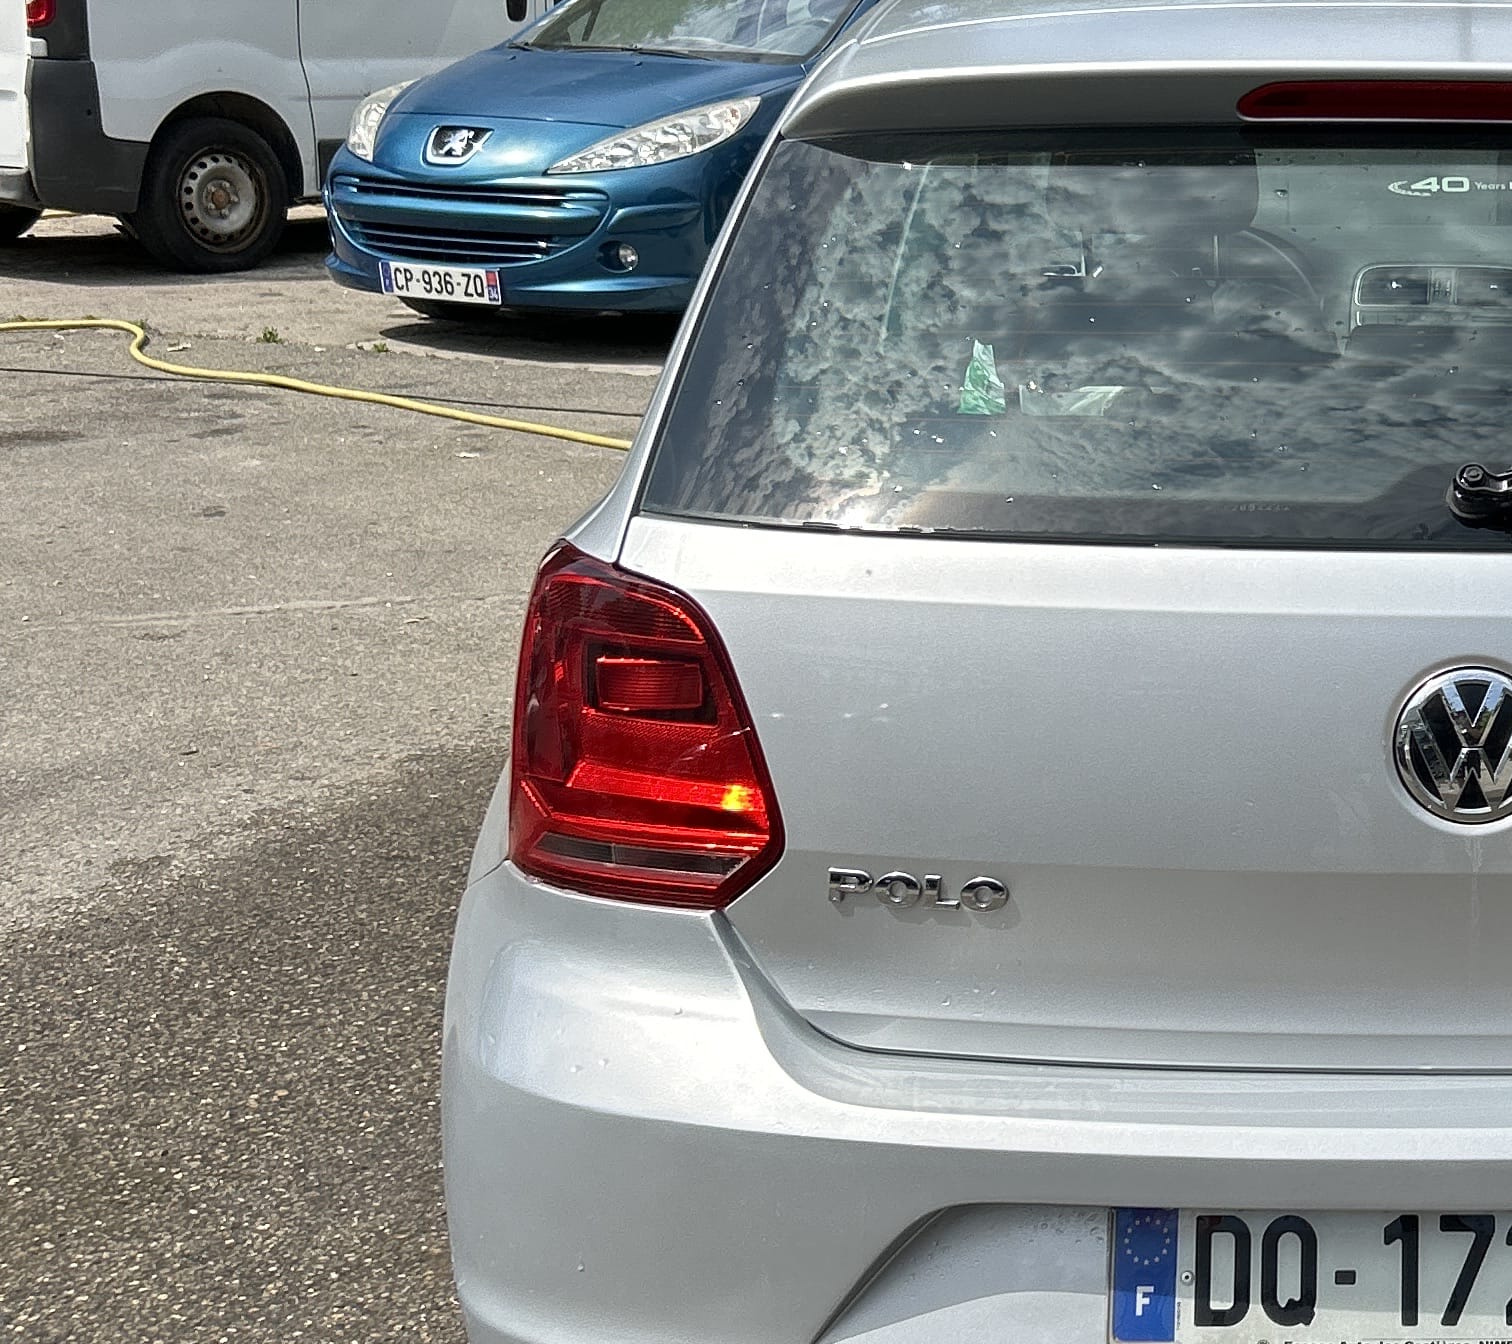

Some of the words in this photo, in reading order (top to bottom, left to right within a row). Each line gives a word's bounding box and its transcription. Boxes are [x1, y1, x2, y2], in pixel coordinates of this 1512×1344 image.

[1410, 176, 1470, 192] 40
[1474, 181, 1505, 190] Years
[828, 866, 1009, 913] POLO
[1135, 1285, 1155, 1316] F
